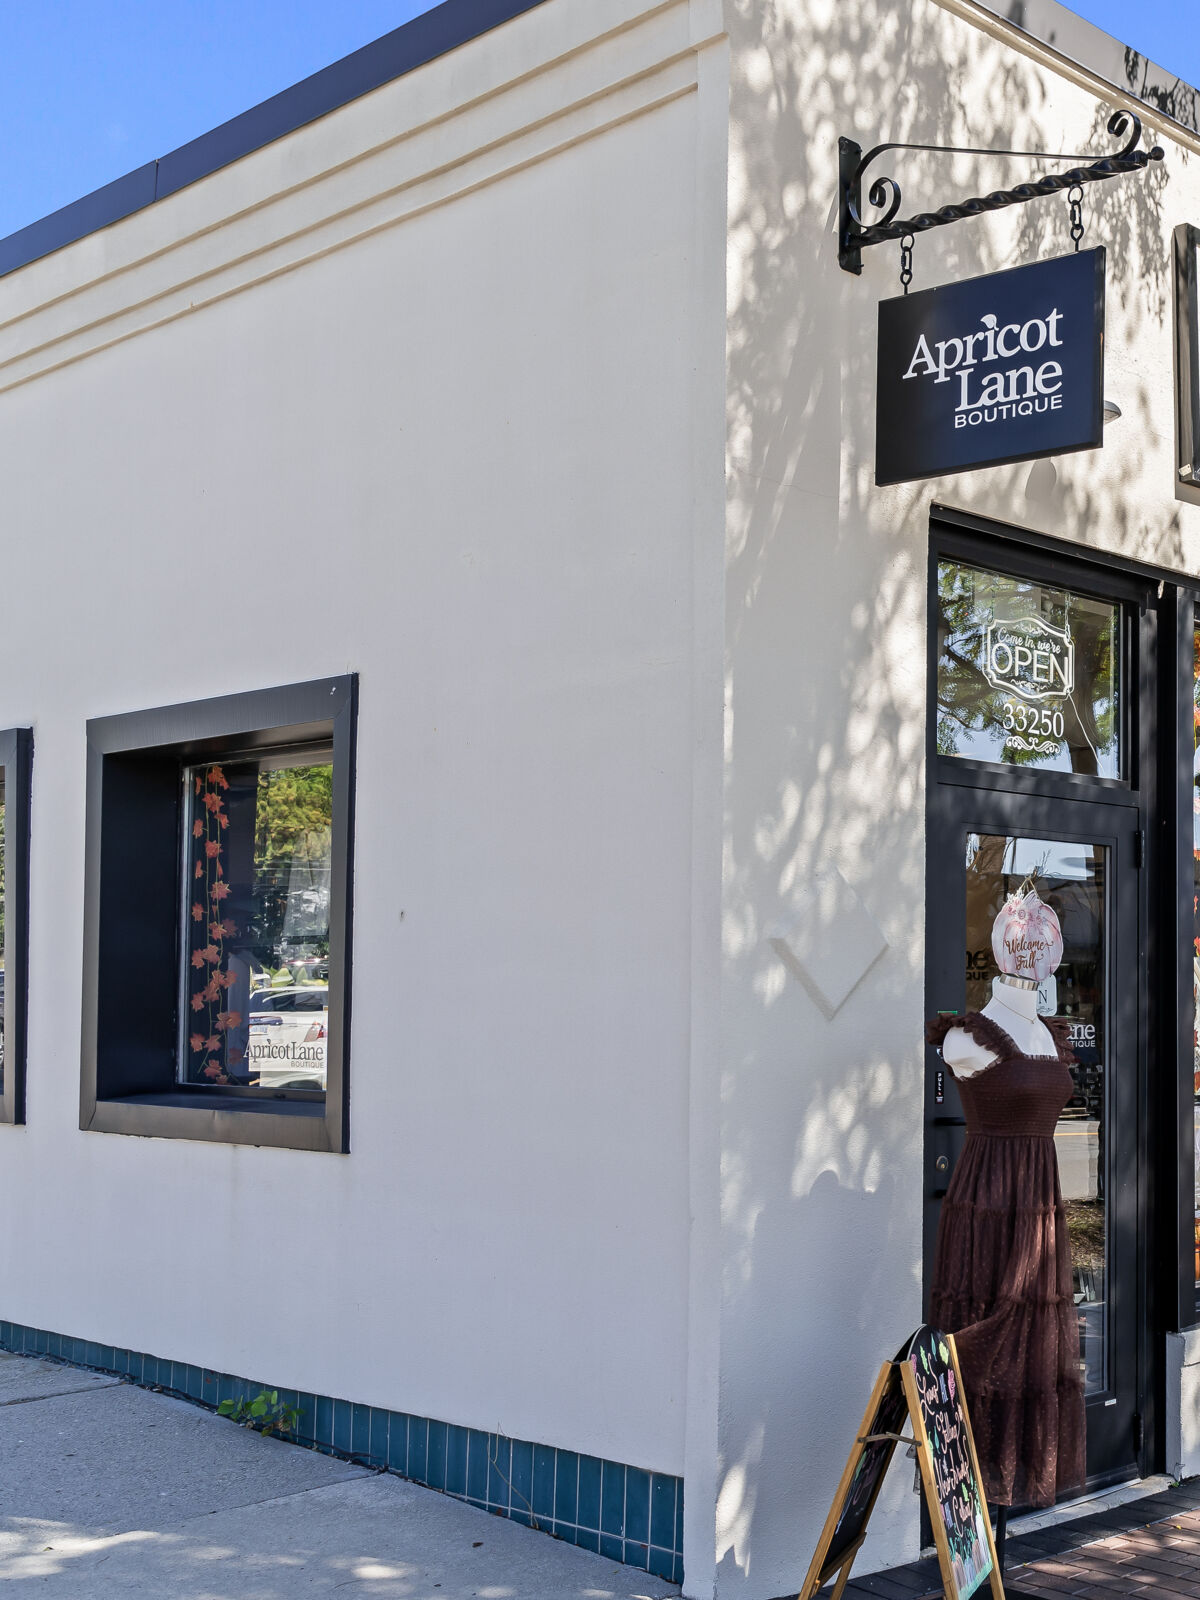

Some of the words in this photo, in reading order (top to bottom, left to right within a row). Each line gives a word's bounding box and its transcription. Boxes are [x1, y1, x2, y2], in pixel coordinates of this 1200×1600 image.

[902, 308, 1063, 383] Apricot
[954, 360, 1063, 412] Lane
[954, 394, 1063, 429] BOUTIQUE
[997, 626, 1024, 646] Come
[991, 642, 1069, 689] OPEN
[1002, 702, 1065, 738] 33250
[1004, 934, 1054, 954] Welcome
[1016, 951, 1044, 970] Fall
[291, 1061, 325, 1069] BOUTIQUE
